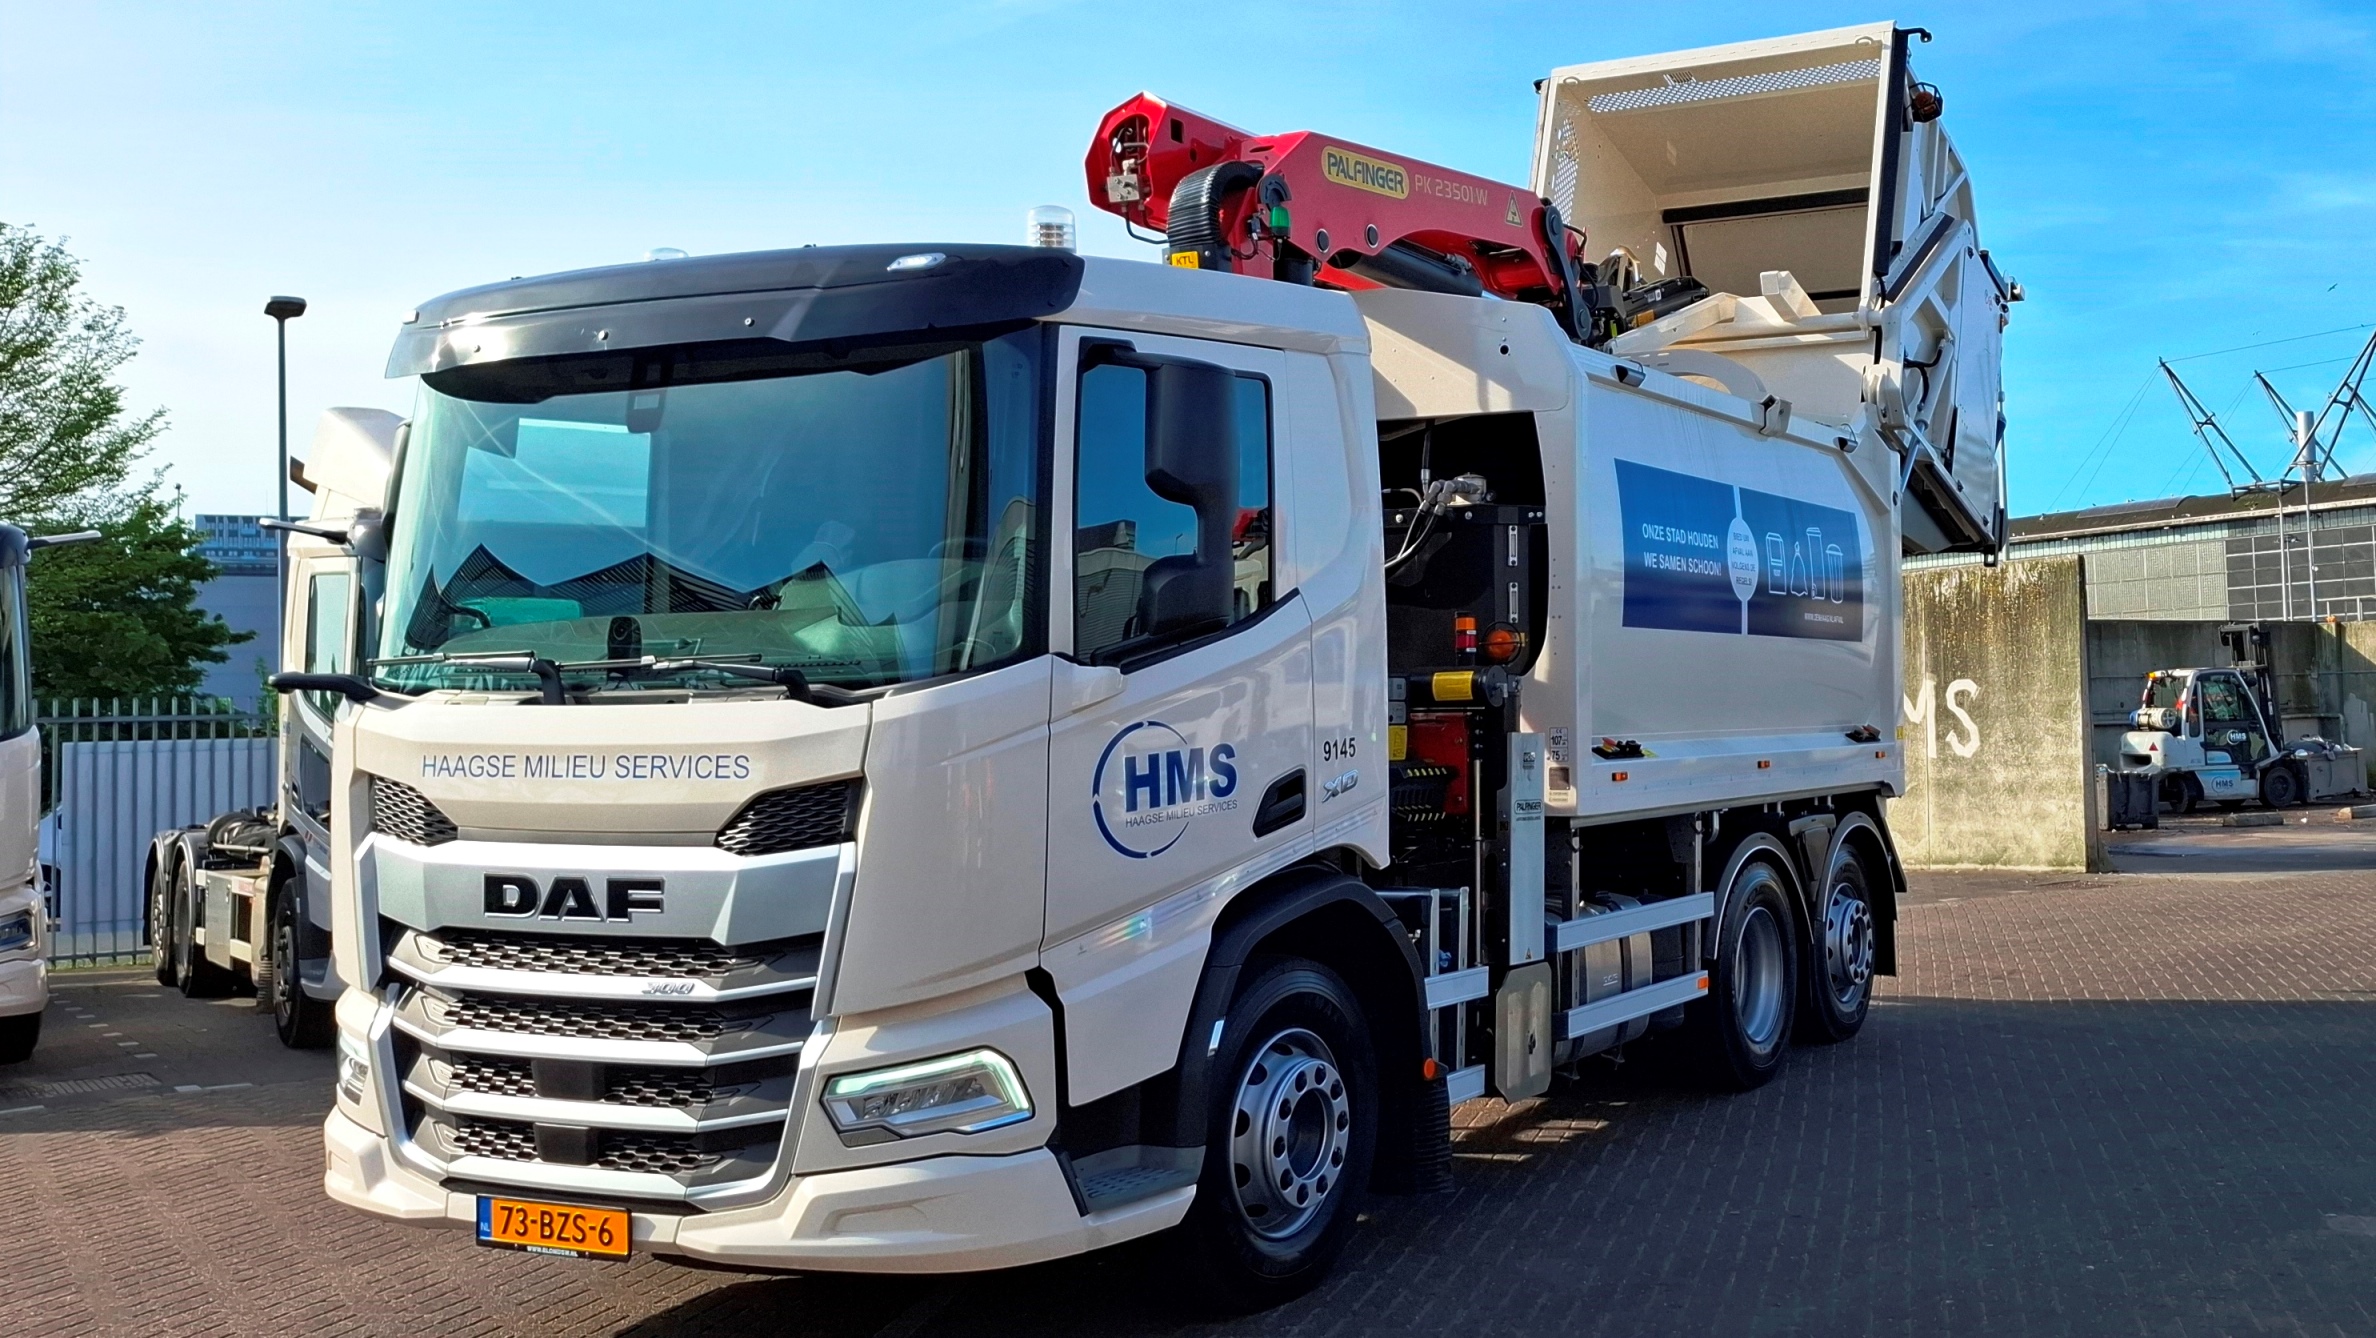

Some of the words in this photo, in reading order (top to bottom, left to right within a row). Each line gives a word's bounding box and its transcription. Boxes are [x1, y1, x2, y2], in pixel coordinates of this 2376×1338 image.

[1327, 152, 1405, 194] PALFINGER
[1414, 174, 1431, 194] PK
[1642, 523, 1664, 541] ONZE
[1666, 526, 1686, 545] STAD
[1688, 531, 1719, 549] HOUDEN
[1643, 551, 1657, 568] WE
[1659, 554, 1687, 572] SAMEN
[1688, 558, 1721, 577] SCHOON!
[1551, 736, 1562, 746] 107
[2230, 732, 2247, 740] HMS
[1323, 737, 1356, 761] 9145
[1552, 750, 1560, 761] 75
[422, 755, 516, 778] HAAGSE
[524, 755, 606, 779] MILIEU
[615, 755, 750, 780] SERVICES
[1124, 743, 1237, 813] HMS
[2215, 779, 2234, 788] HMS
[1125, 812, 1164, 828] HAAGSE
[1166, 808, 1195, 821] MILIEU
[1197, 799, 1238, 816] SERVICES
[484, 872, 666, 923] DAF
[480, 1222, 491, 1232] NL
[500, 1205, 613, 1247] 73-BZS-6
